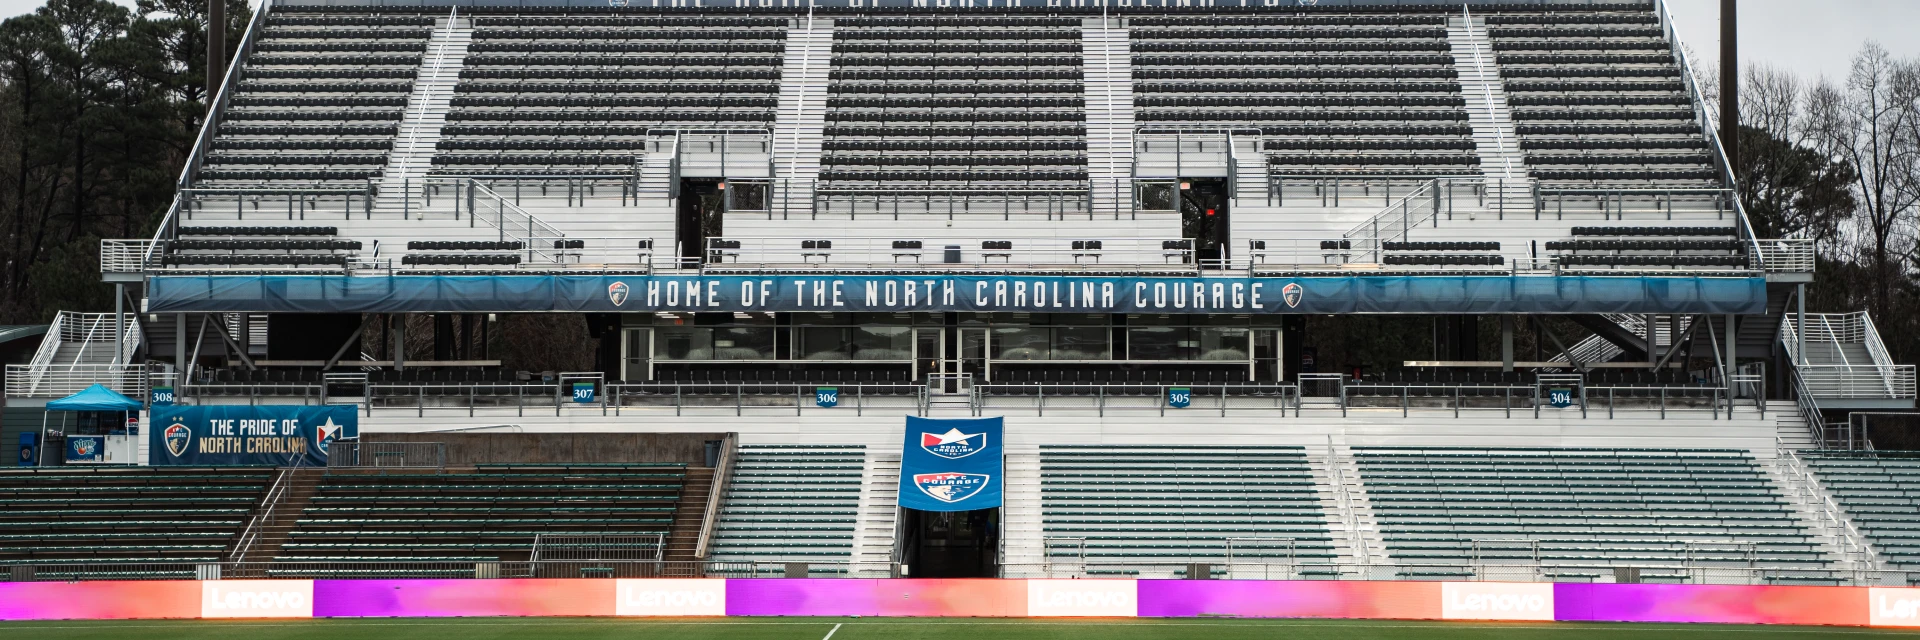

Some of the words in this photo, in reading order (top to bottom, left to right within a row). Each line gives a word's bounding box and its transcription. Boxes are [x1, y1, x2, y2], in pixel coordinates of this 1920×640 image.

[647, 280, 720, 307] HOME
[741, 280, 772, 307] OF
[794, 280, 844, 307] THE
[866, 280, 955, 307] NORTH
[975, 280, 1114, 308] CAROLINA
[1135, 281, 1263, 309] COURAGE
[152, 392, 173, 403] 308
[573, 388, 594, 399] 307
[817, 392, 837, 403] 306
[1169, 393, 1190, 404] 305
[1551, 391, 1571, 404] 304
[210, 419, 235, 436] THE
[239, 419, 277, 436] PRIDE
[282, 419, 299, 436] OF
[199, 437, 242, 454] NORTH
[211, 587, 304, 609] Lenovo
[625, 584, 717, 607] Lenovo
[1036, 586, 1129, 607] Lenovo
[1451, 588, 1545, 612] Lenovo
